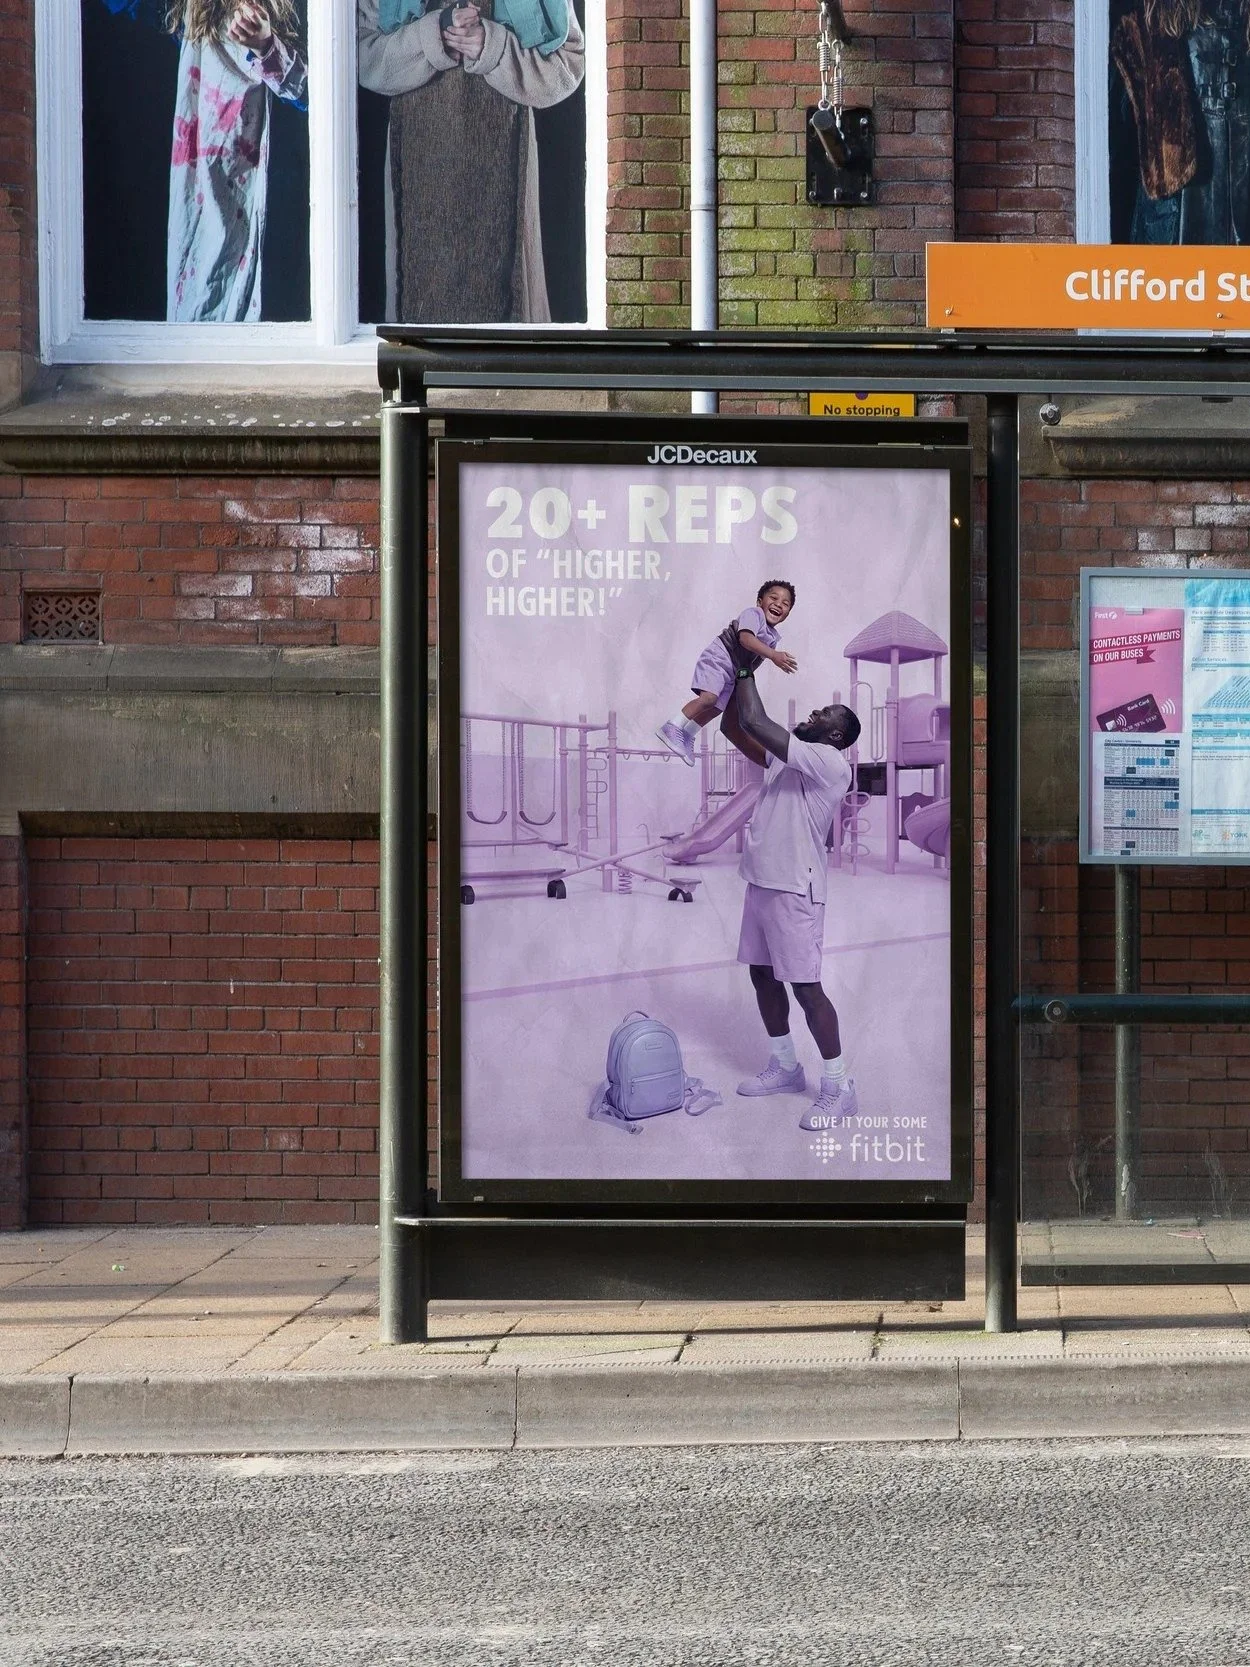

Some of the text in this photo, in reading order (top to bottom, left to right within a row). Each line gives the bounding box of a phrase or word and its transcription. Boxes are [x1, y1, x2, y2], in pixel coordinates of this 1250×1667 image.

[1065, 269, 1205, 301] Clifford
[823, 404, 901, 417] No stopping
[647, 445, 758, 464] JCDecaux
[486, 484, 799, 545] 20+ REPS
[486, 548, 527, 579] OF
[1094, 611, 1109, 619] First
[1093, 630, 1181, 649] CONTACTLESS PAYMENTS
[1093, 648, 1144, 662] ON OUR BUSES
[810, 1116, 927, 1129] GIVE IT YOUR SOME
[849, 1133, 926, 1162] fitbit
